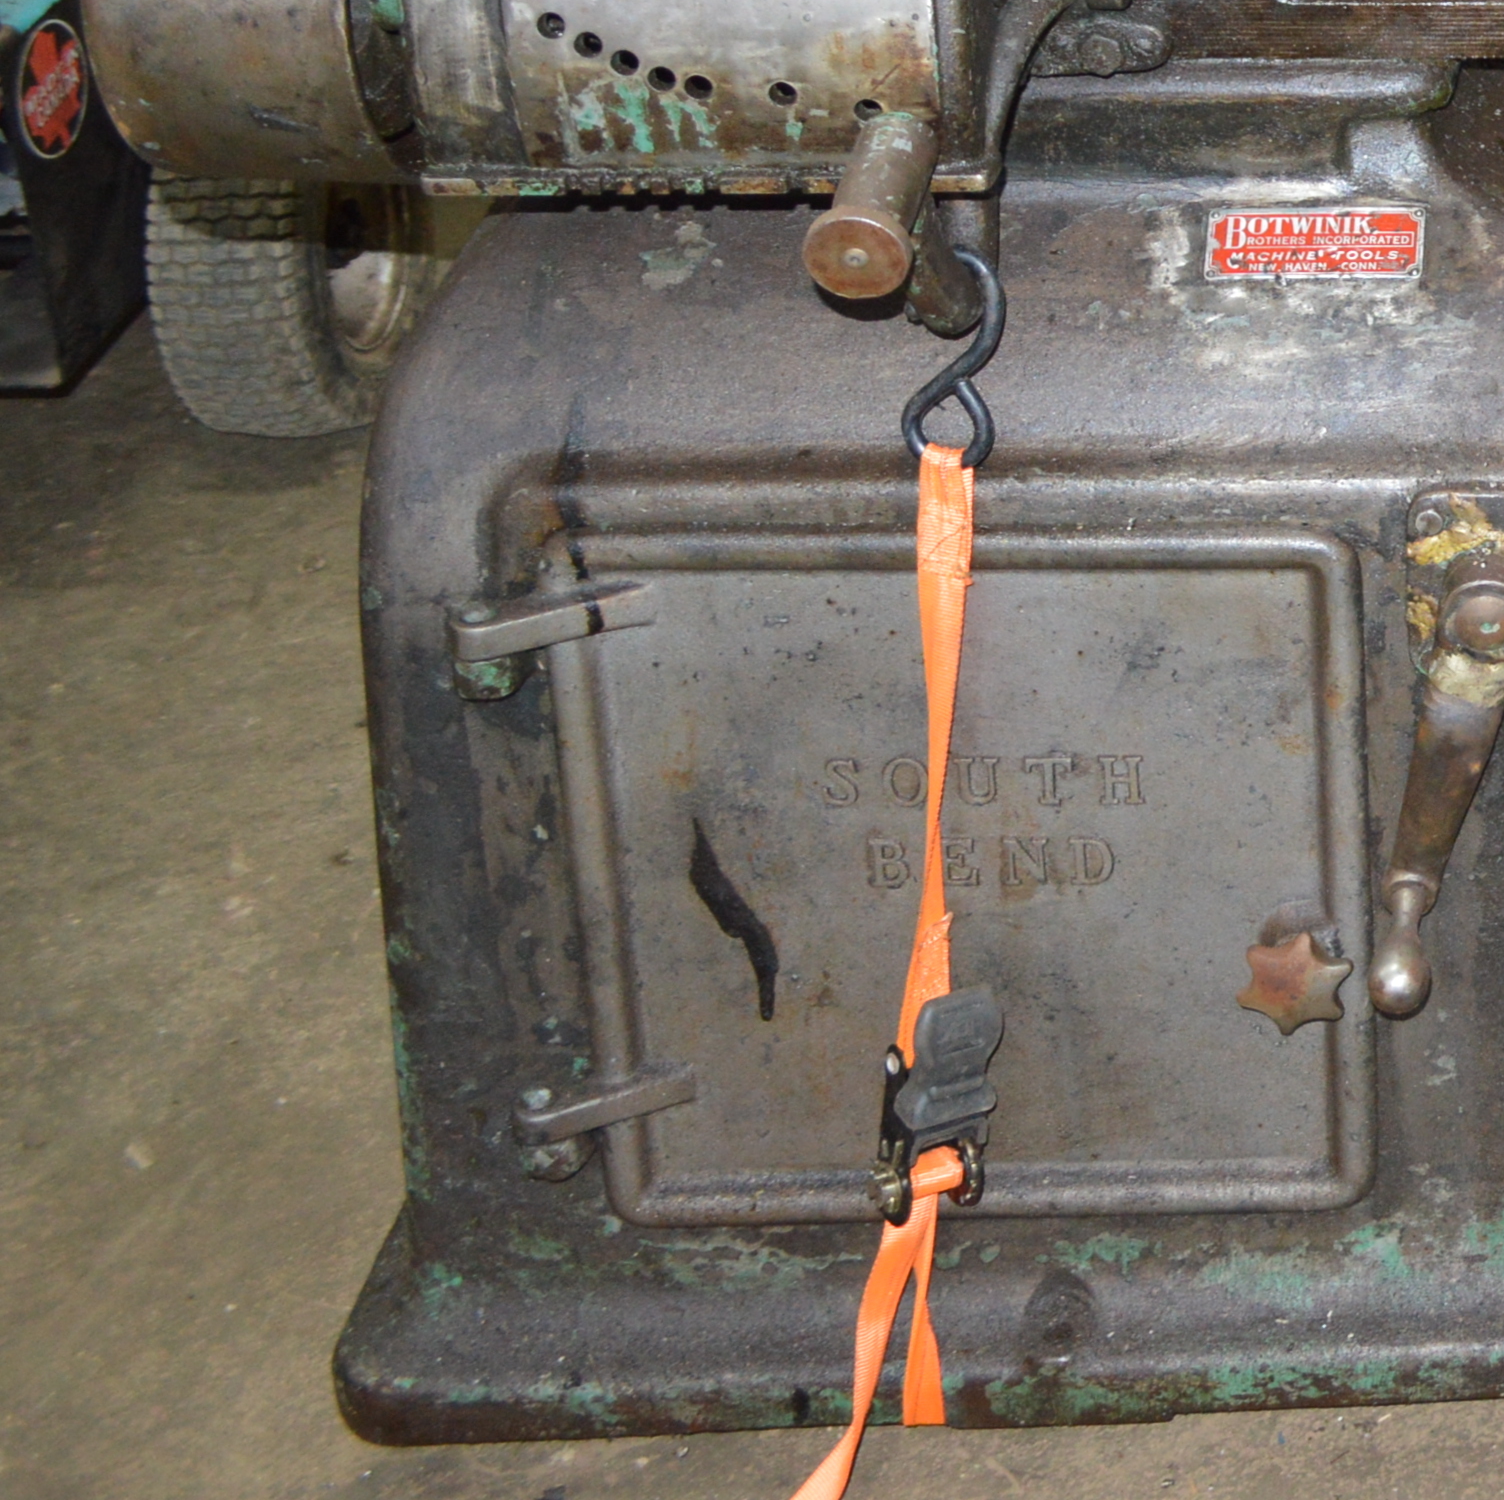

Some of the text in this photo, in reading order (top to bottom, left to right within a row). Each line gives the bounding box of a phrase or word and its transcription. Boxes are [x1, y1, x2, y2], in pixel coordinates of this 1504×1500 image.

[1224, 215, 1377, 250] BOTWINIK
[1313, 234, 1410, 245] INCORPORATED
[1230, 250, 1400, 262] MACHINE TOOLS
[822, 753, 1147, 808] SOUTH
[866, 835, 1118, 890] BEND
